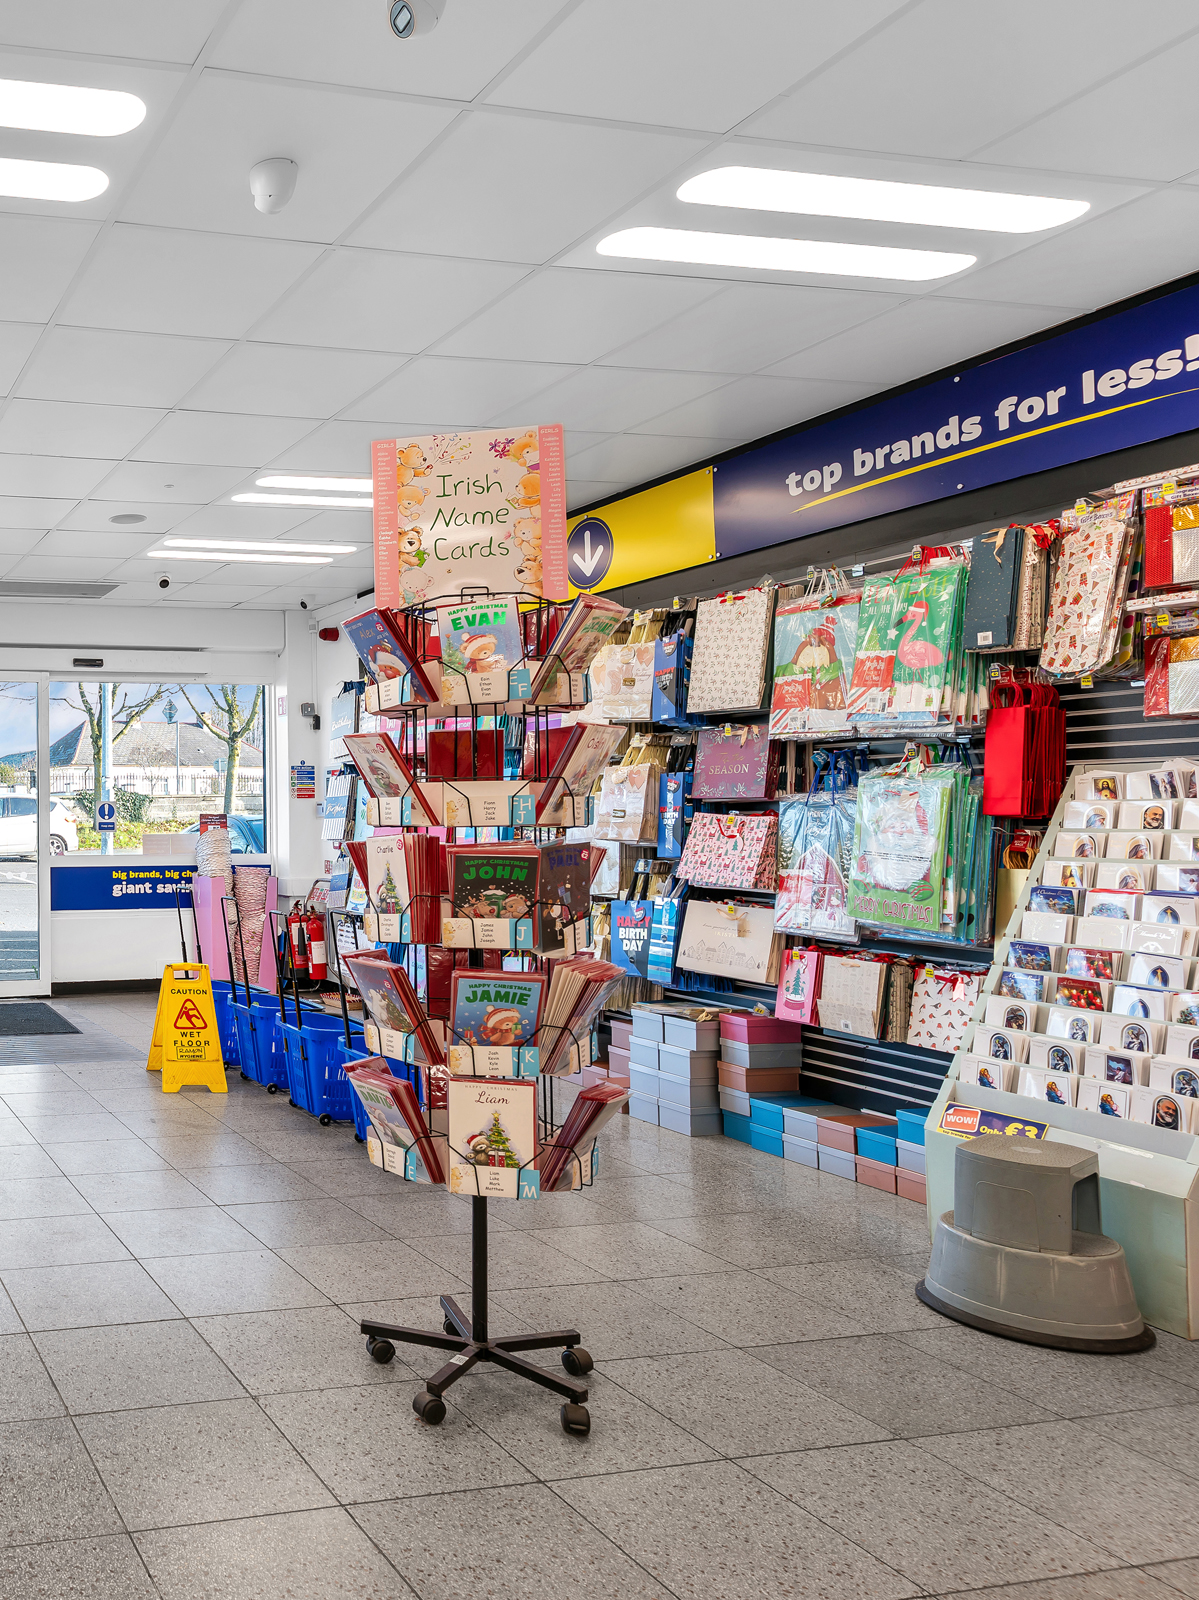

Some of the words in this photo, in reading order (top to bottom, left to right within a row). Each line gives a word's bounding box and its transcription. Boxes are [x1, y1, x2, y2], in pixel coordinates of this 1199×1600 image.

[786, 462, 842, 498] top
[854, 414, 984, 475] brands
[995, 385, 1066, 432] for
[1082, 334, 1199, 405] less!
[436, 474, 502, 498] Irish
[430, 507, 510, 531] Name
[434, 536, 510, 560] Cards
[447, 607, 469, 616] HAPPY
[470, 603, 508, 611] CHRISTMAS
[450, 612, 507, 632] EVAN
[360, 628, 374, 640] Alex
[655, 666, 675, 677] HAPPY
[708, 763, 750, 774] SEASON
[520, 798, 532, 810] H
[376, 846, 394, 854] Charlie
[549, 855, 579, 869] PAUL
[112, 871, 127, 880] big
[129, 870, 163, 879] brands,
[165, 870, 179, 879] big
[463, 866, 528, 881] JOHN
[112, 881, 152, 897] giant
[854, 894, 880, 915] MERRY
[882, 898, 933, 925] CHRISTMAS!
[617, 916, 651, 927] HAPPY
[517, 926, 527, 941] J
[619, 928, 648, 939] BIRTH
[622, 940, 643, 951] DAY
[493, 984, 532, 992] CHRISTMAS
[465, 990, 531, 1006] JAMIE
[526, 1051, 534, 1063] K
[474, 1090, 510, 1105] Liam
[946, 1114, 977, 1124] WOW!
[980, 1125, 1003, 1135] Only
[1005, 1122, 1038, 1139] €3
[523, 1185, 536, 1198] M
